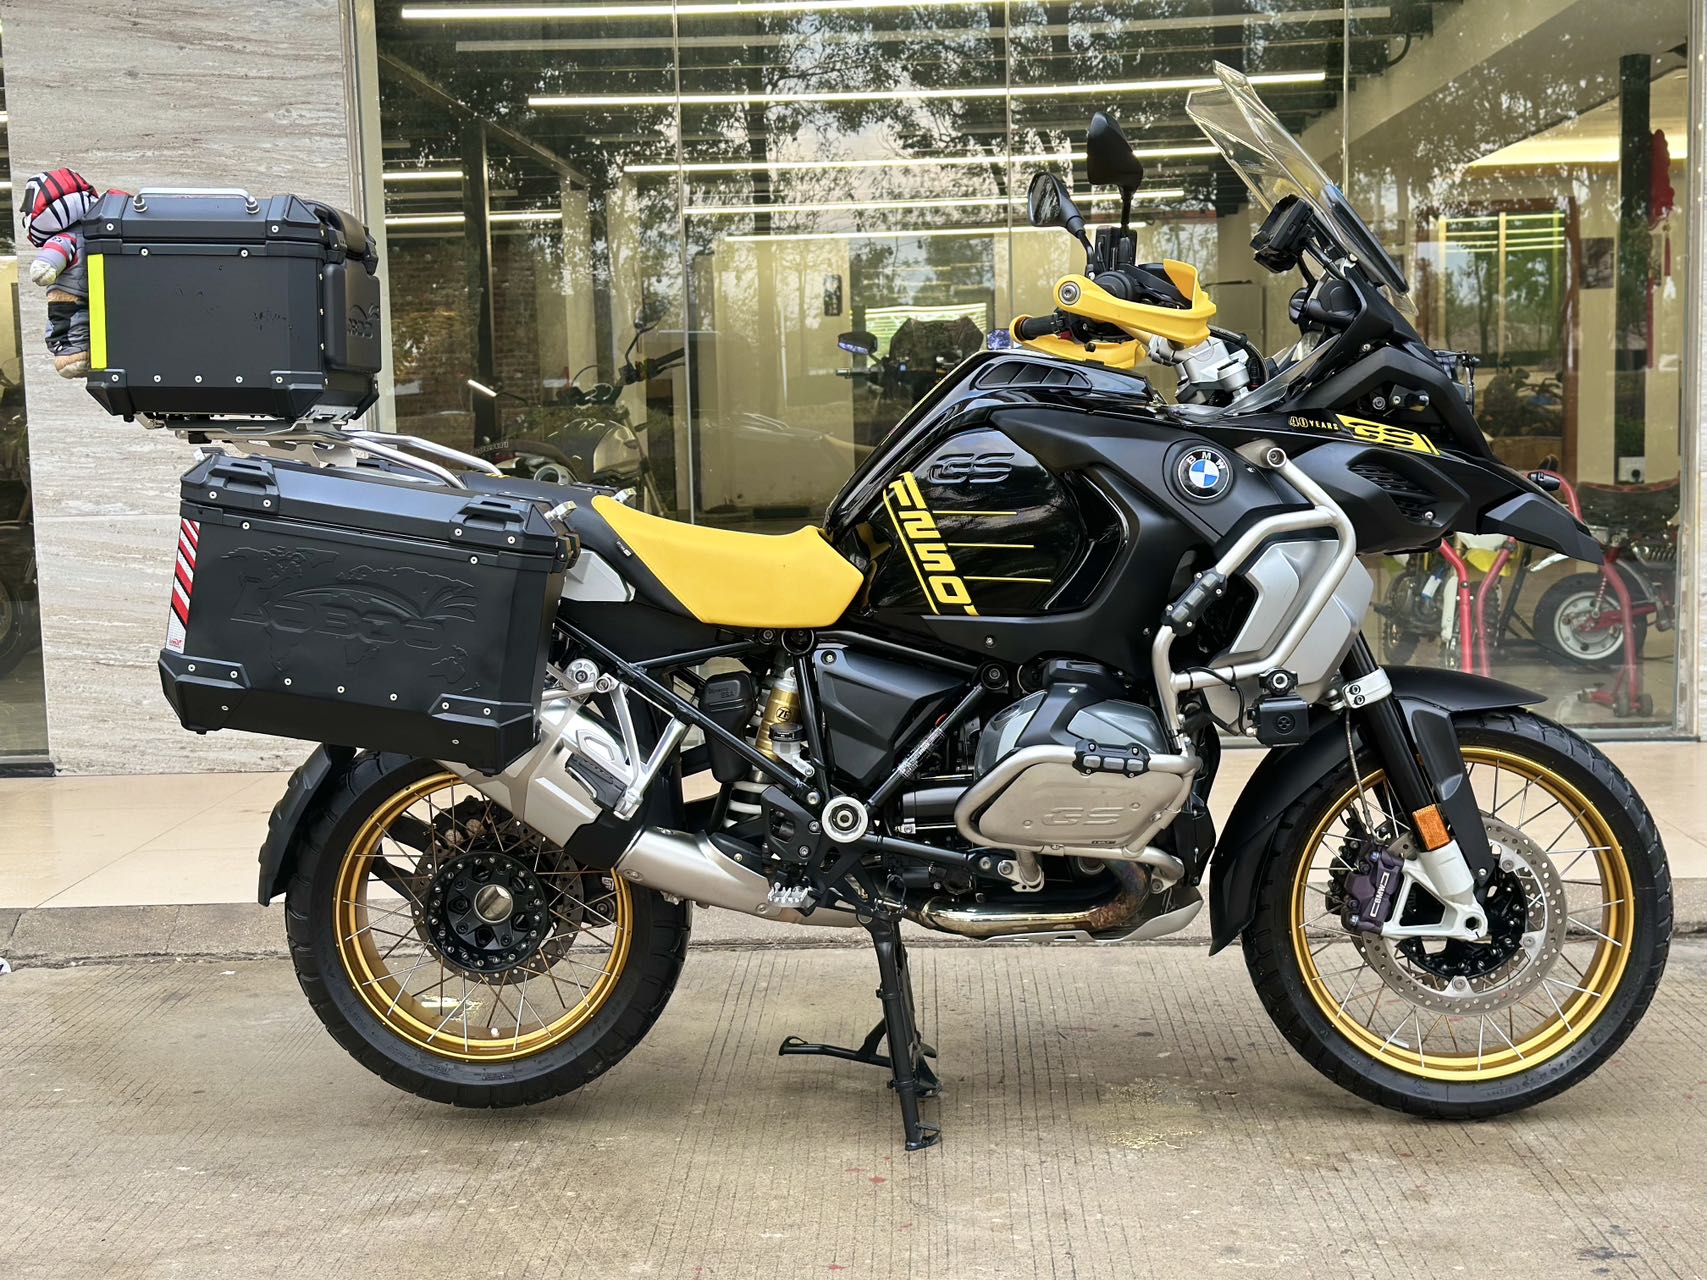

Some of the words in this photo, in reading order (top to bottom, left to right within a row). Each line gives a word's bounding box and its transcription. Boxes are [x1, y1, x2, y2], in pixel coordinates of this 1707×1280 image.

[1289, 416, 1309, 428] 40
[1309, 420, 1339, 431] YEARS
[927, 452, 1015, 484] GS
[1186, 450, 1226, 471] BMW
[1043, 807, 1123, 825] GS
